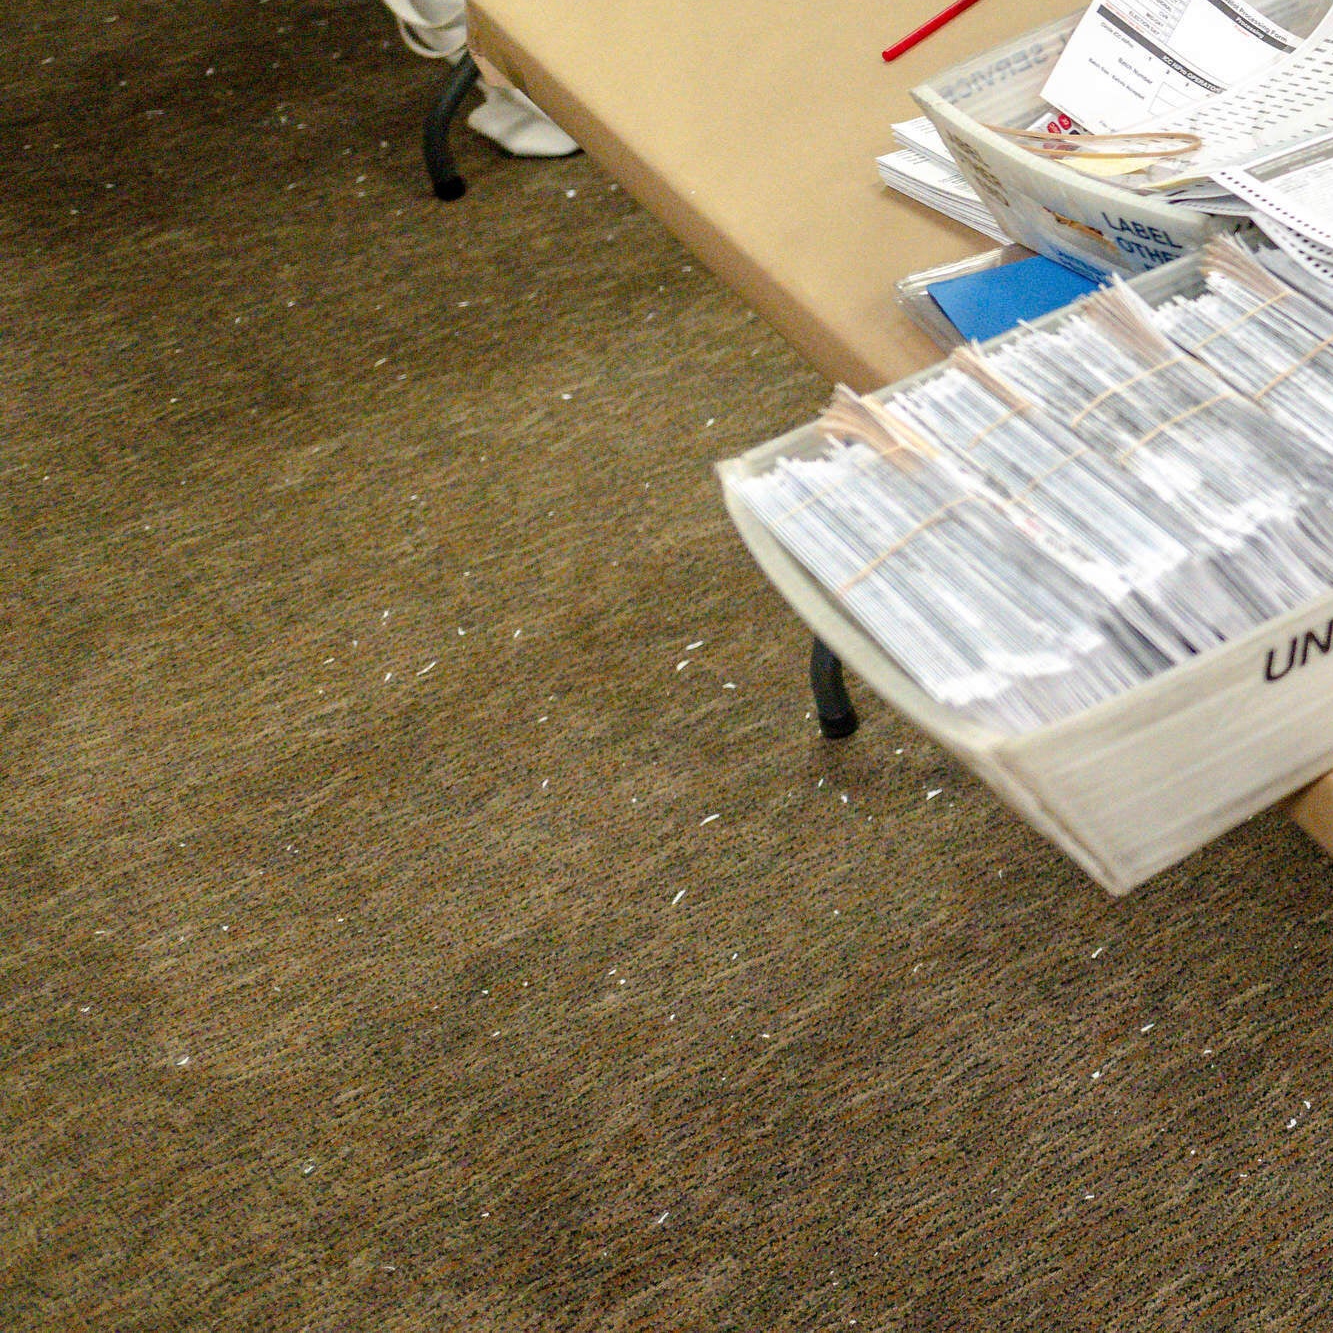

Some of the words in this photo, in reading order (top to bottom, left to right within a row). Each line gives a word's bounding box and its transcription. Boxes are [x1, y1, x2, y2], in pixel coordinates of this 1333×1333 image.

[1235, 17, 1265, 39] Processing
[1238, 5, 1271, 35] Processing
[1270, 30, 1289, 43] Form
[1118, 57, 1132, 70] Batch
[1132, 67, 1153, 85] Number
[1101, 212, 1184, 249] LABEL
